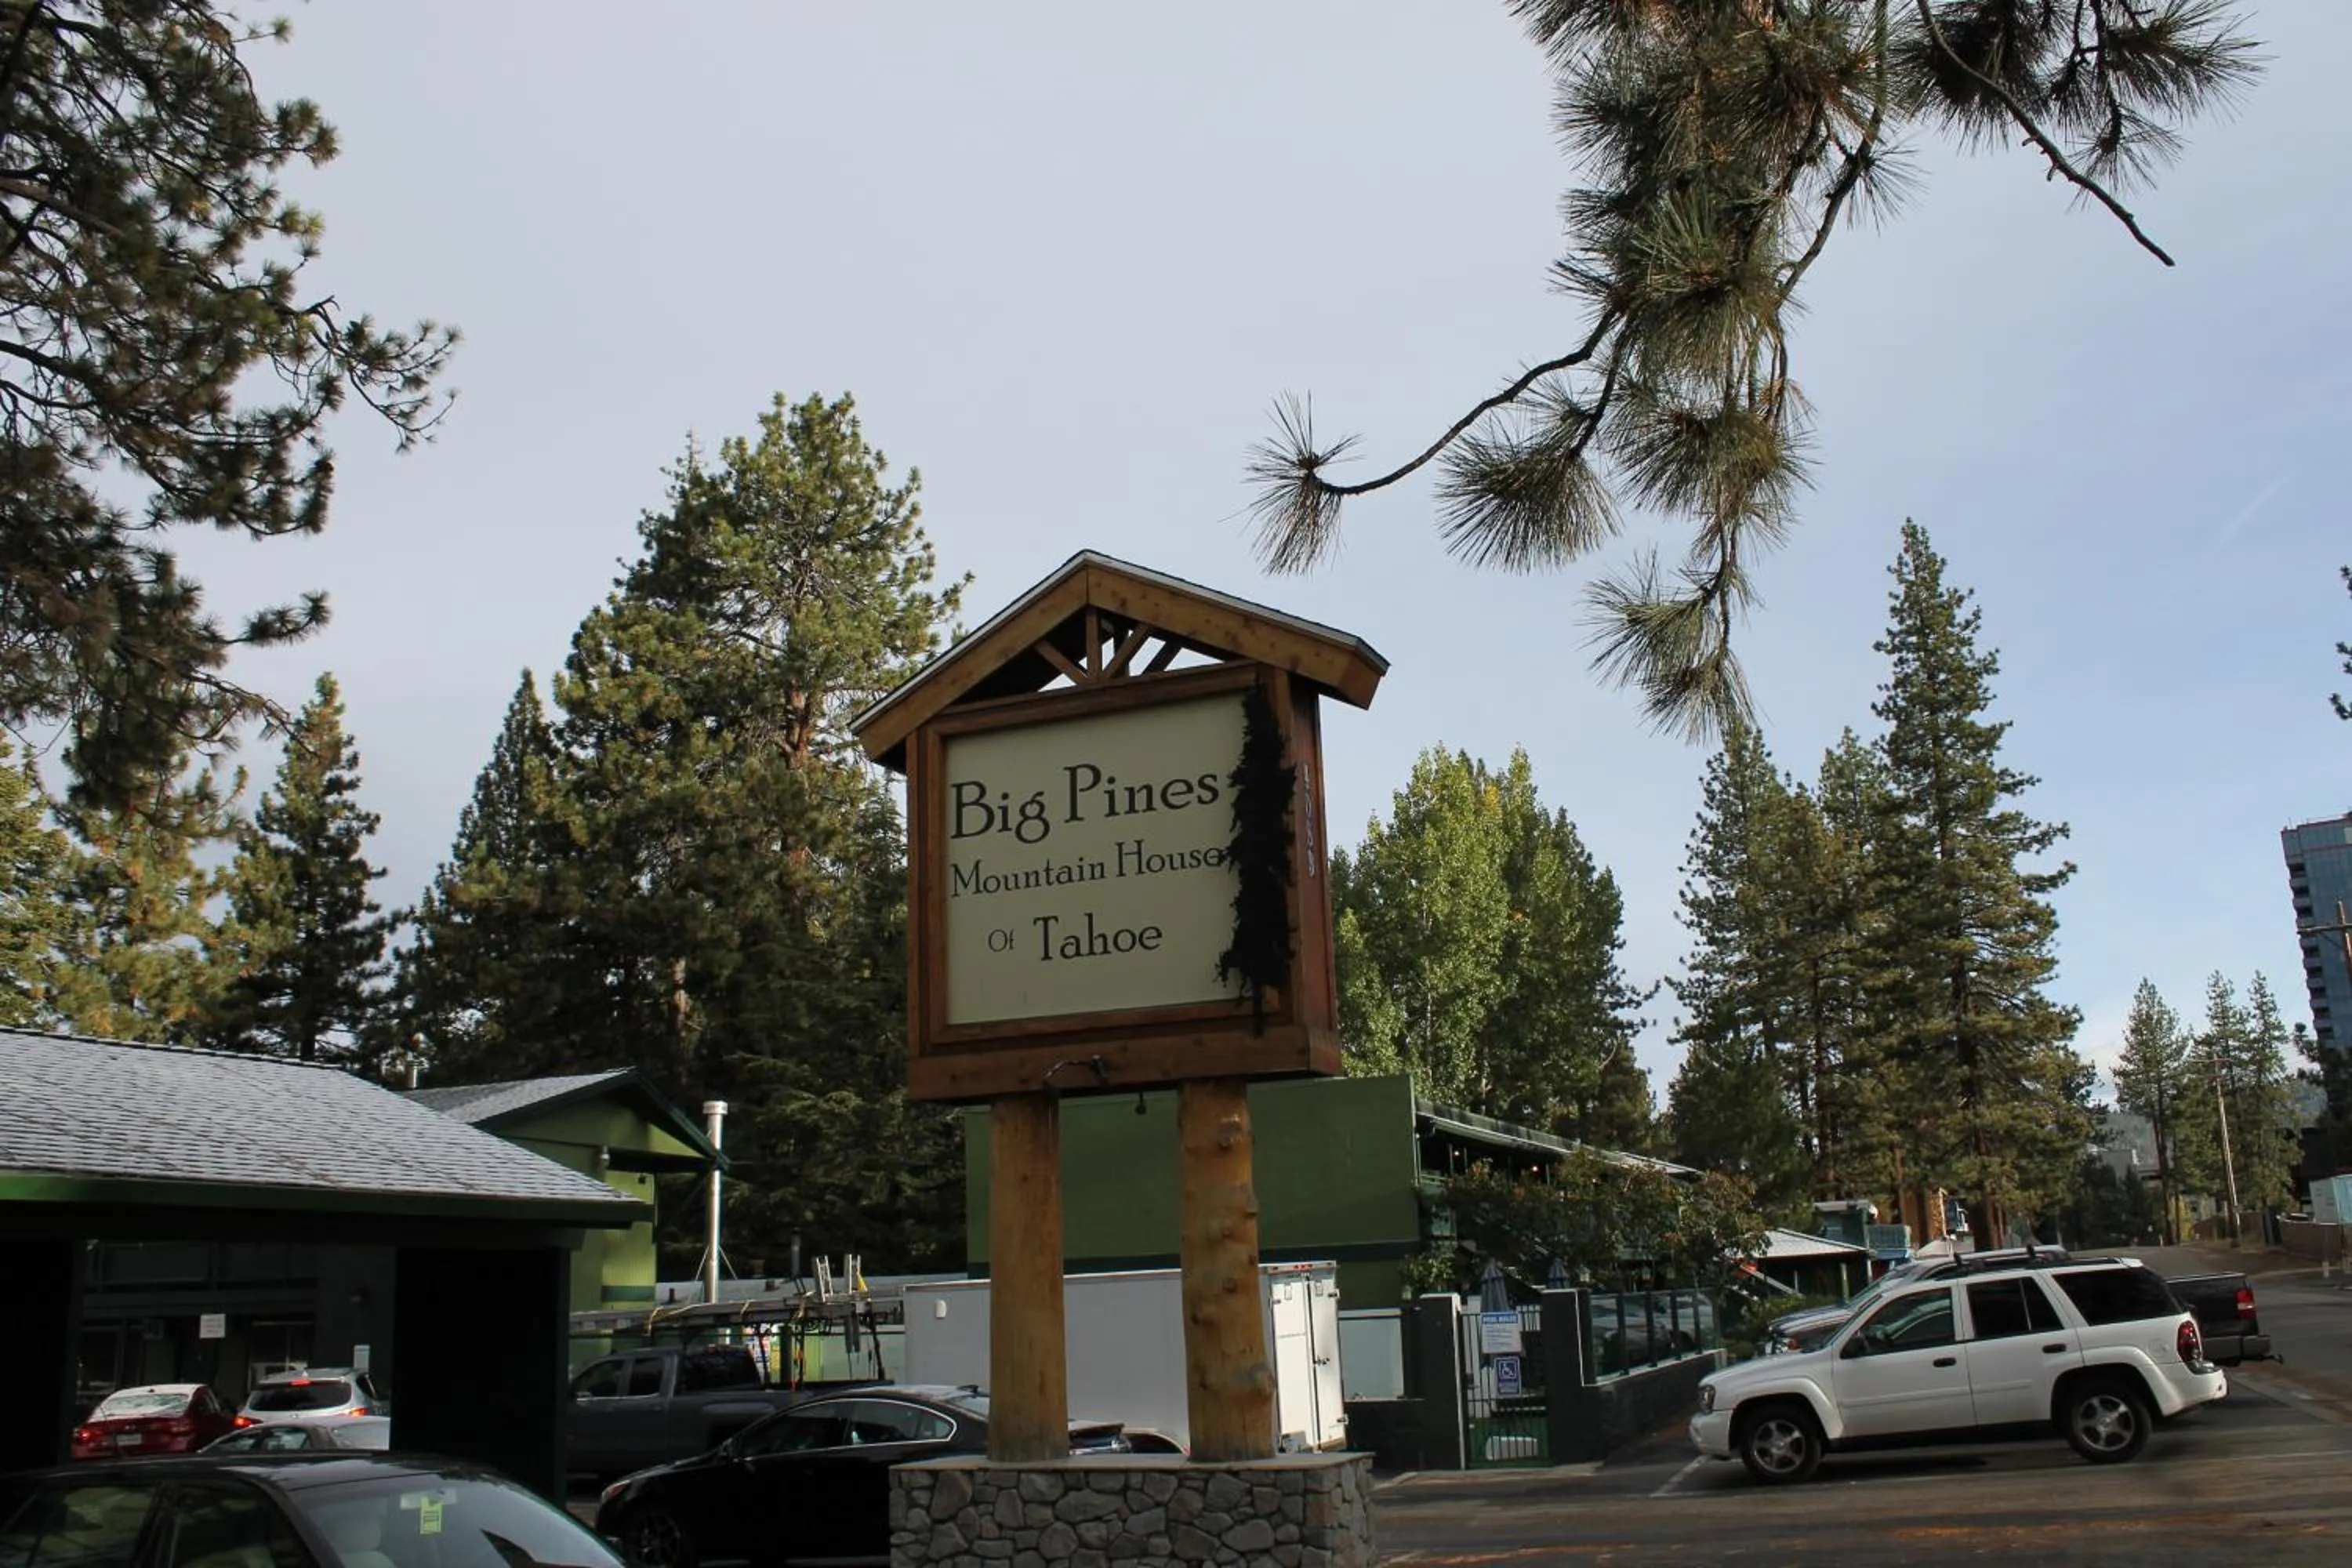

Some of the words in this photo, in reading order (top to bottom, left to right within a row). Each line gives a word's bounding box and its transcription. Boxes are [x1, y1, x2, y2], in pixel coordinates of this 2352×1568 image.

[950, 780, 1051, 844] Big
[1063, 763, 1219, 824] Pines
[951, 858, 1106, 896] Mountain
[1115, 839, 1224, 877] House
[1033, 912, 1163, 961] Tahoe
